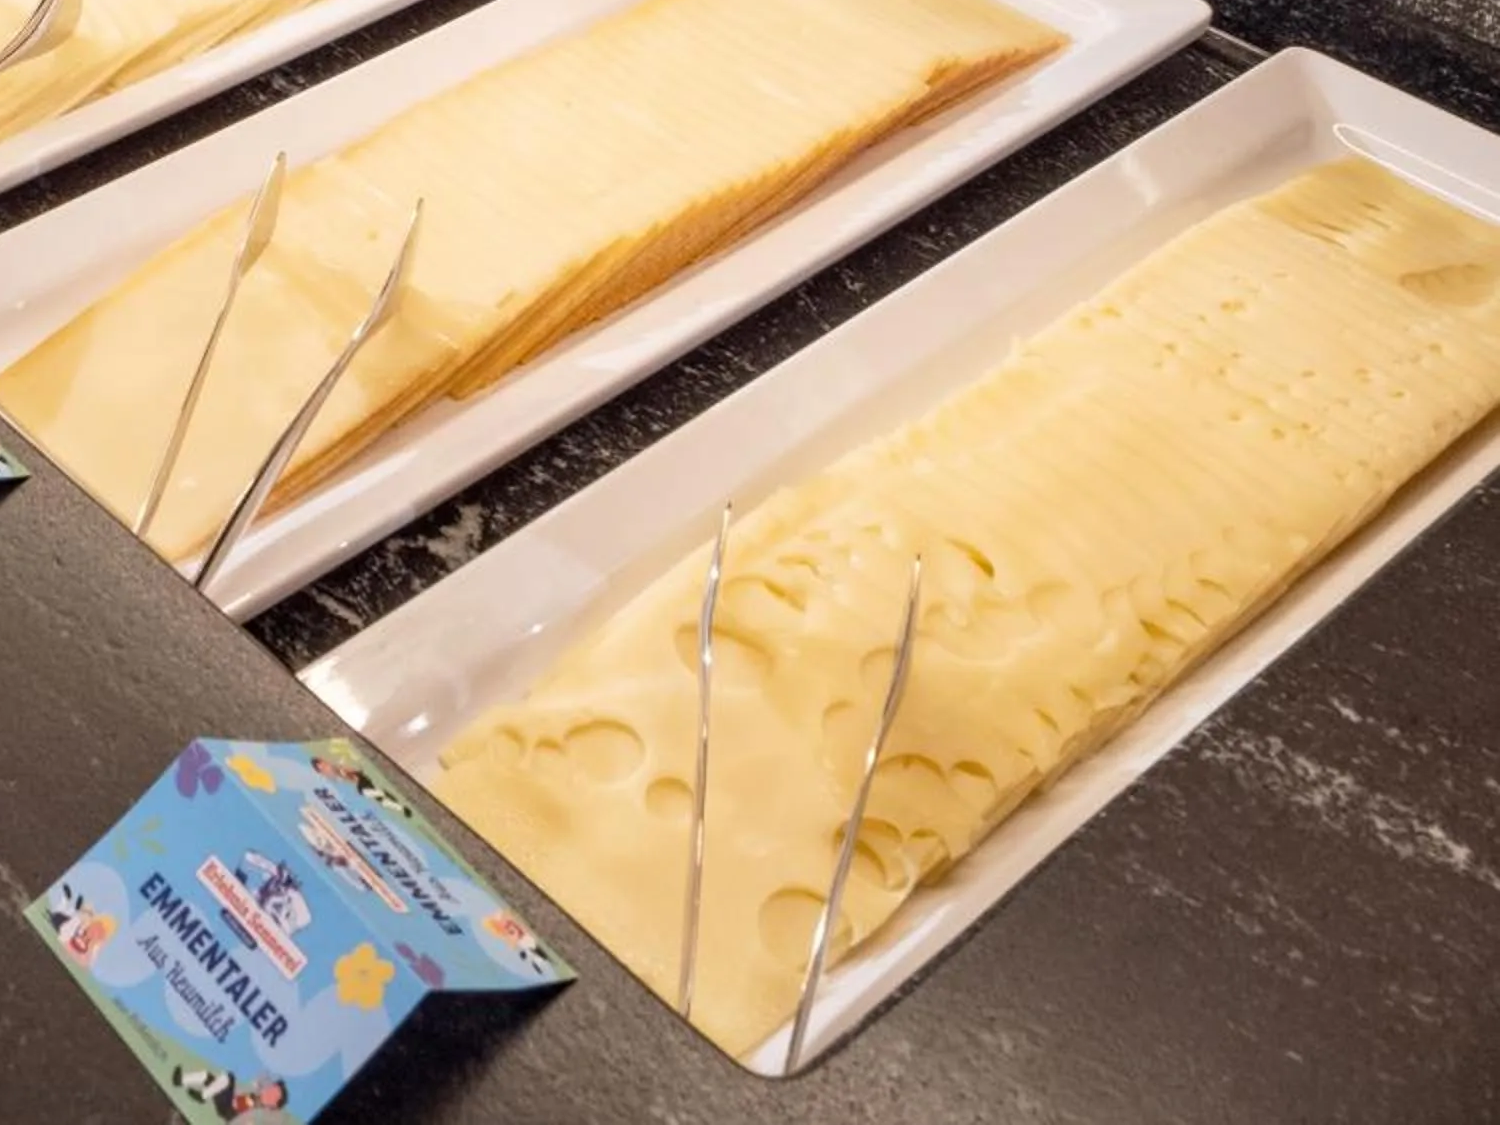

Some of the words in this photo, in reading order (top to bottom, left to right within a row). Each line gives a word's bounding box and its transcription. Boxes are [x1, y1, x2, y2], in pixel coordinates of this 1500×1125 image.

[202, 859, 250, 916] Erlebnis
[248, 910, 302, 975] Sennerei
[313, 786, 465, 936] EMMENTALER
[136, 934, 169, 971] Aus
[165, 959, 236, 1044] Heumilch
[138, 871, 289, 1049] EMMENTALER
